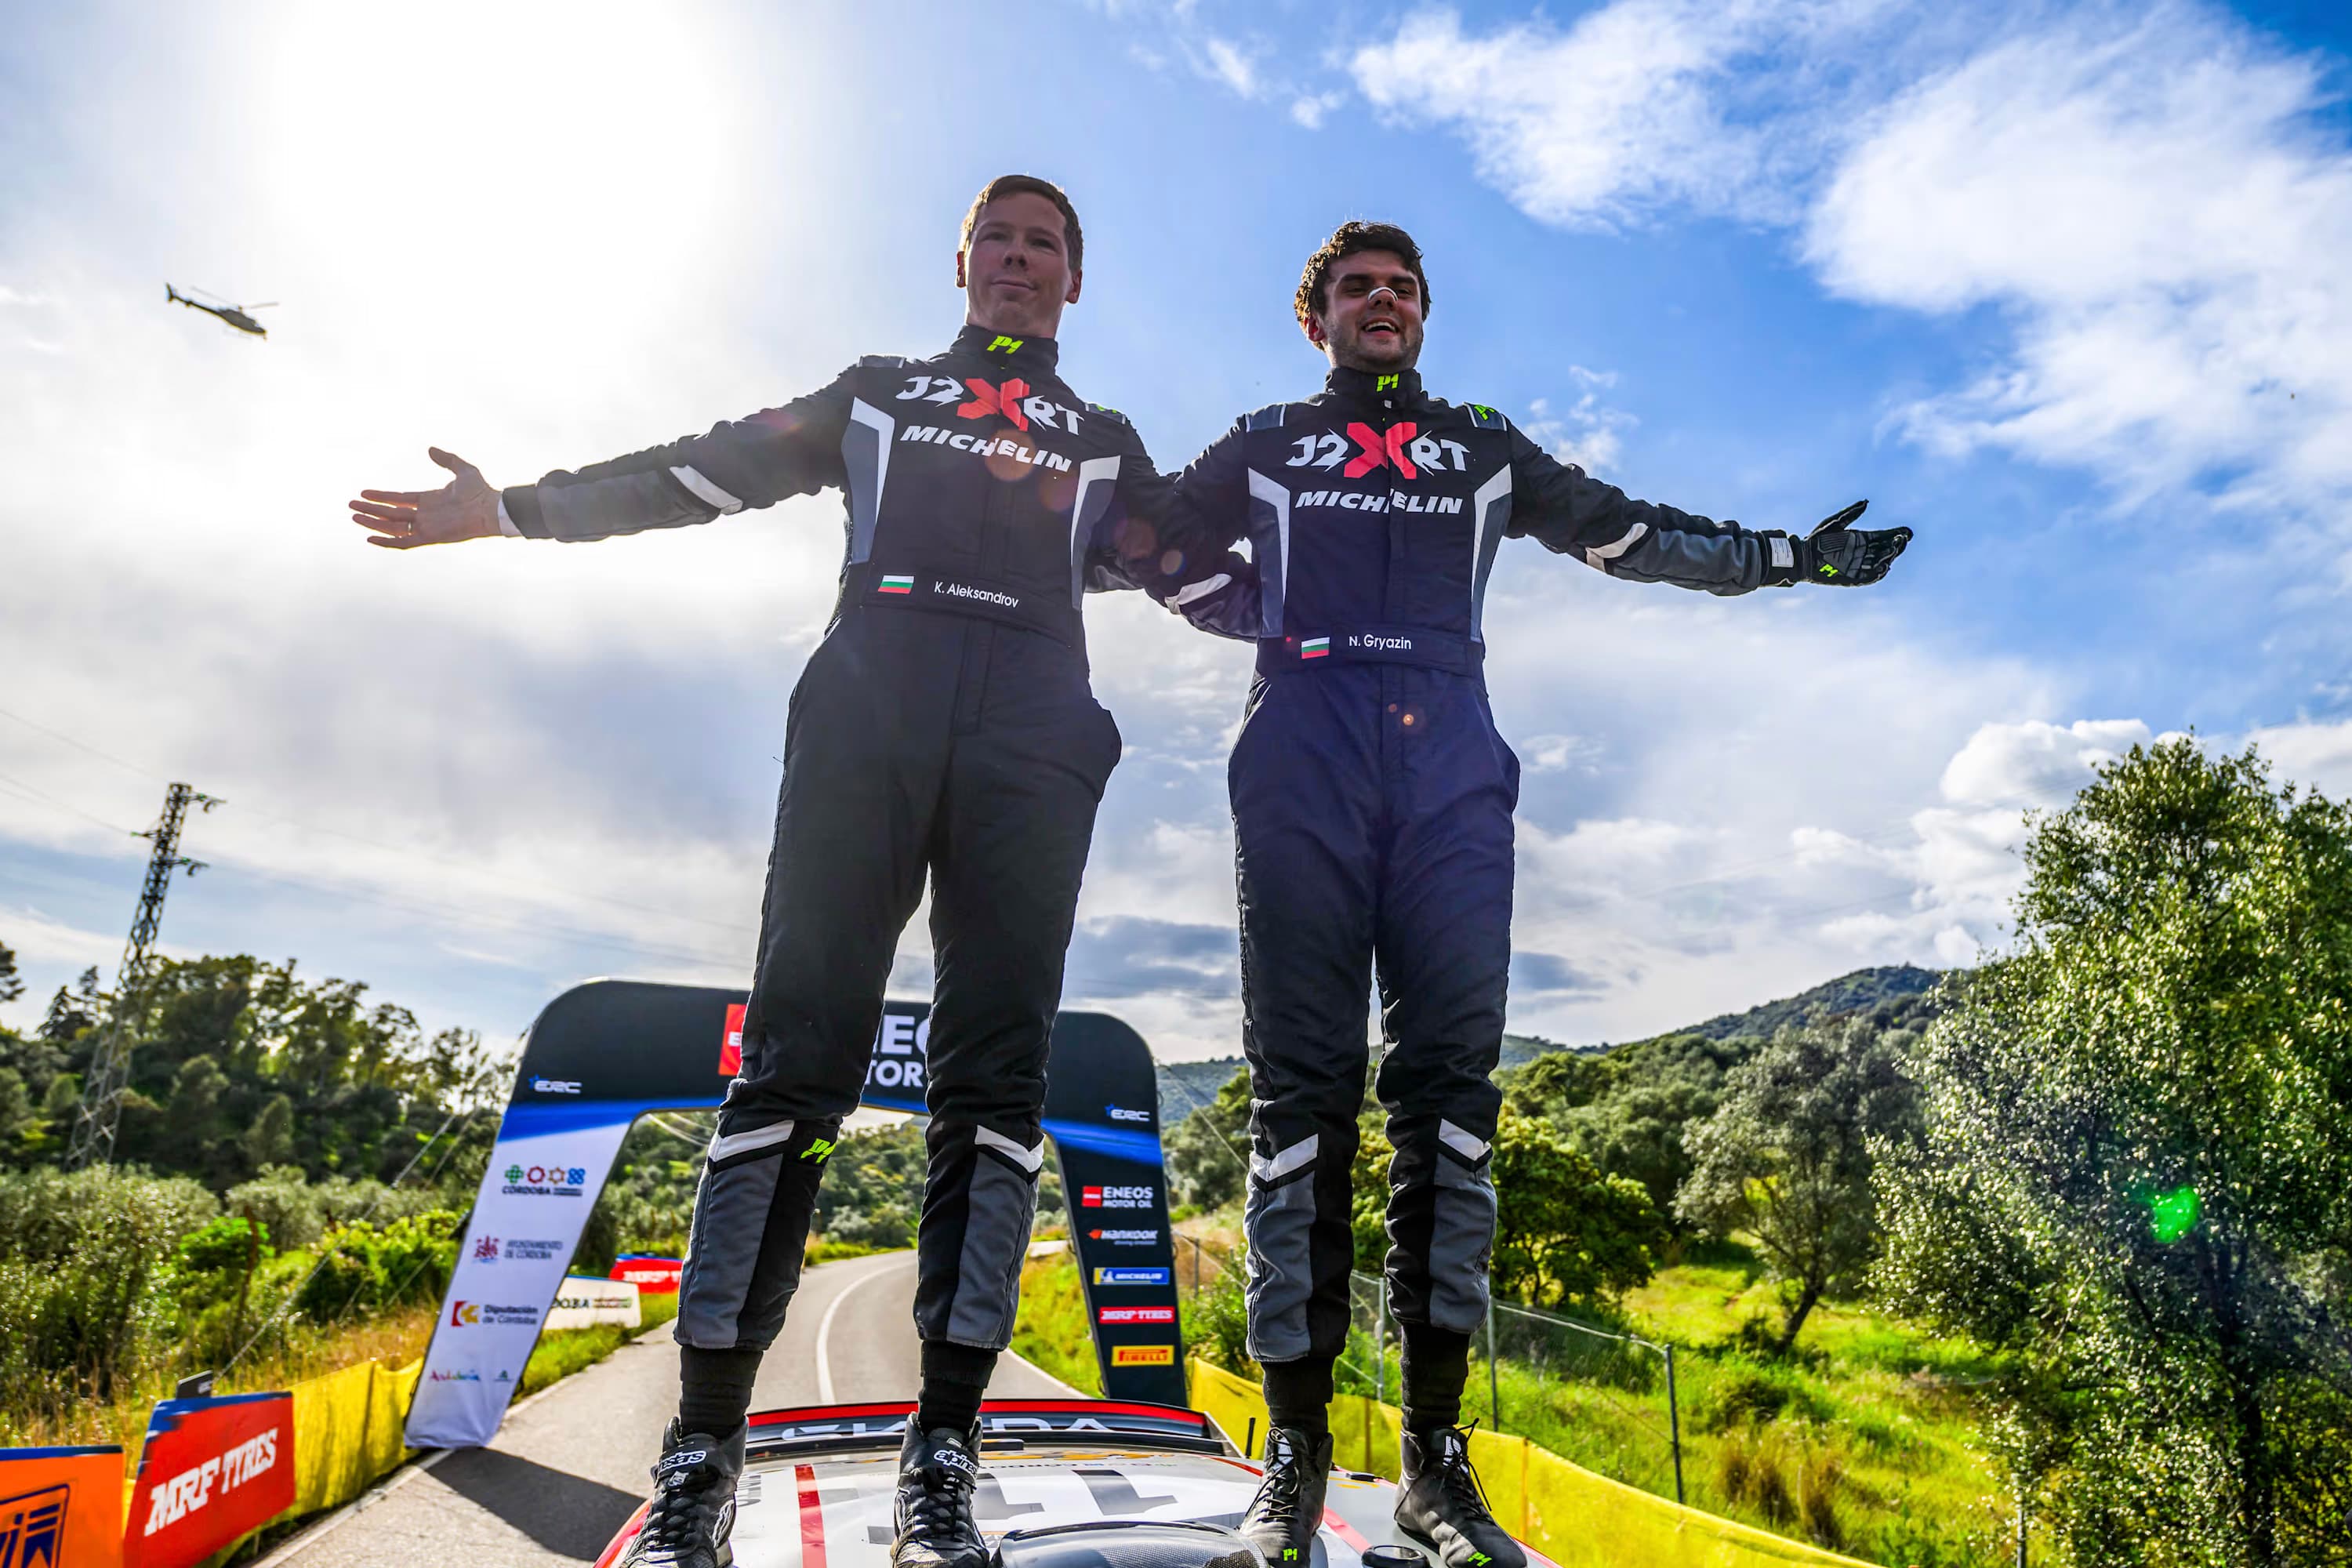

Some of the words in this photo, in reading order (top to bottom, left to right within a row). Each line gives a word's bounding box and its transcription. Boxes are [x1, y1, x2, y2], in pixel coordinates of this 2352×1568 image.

[986, 336, 1024, 354] P1
[1377, 373, 1399, 392] P1
[900, 425, 1073, 473] MICHELIN
[1294, 488, 1464, 514] MICHELIN
[934, 581, 945, 594] K.
[946, 584, 1019, 608] Aleksandrov
[1348, 636, 1361, 647] N.
[1363, 634, 1412, 650] Gryazin
[1102, 1185, 1154, 1200] ENEOS
[1102, 1200, 1136, 1208] MOTOR
[1137, 1200, 1153, 1208] OIL
[144, 1456, 221, 1537] MRF
[221, 1428, 278, 1494] TYRES
